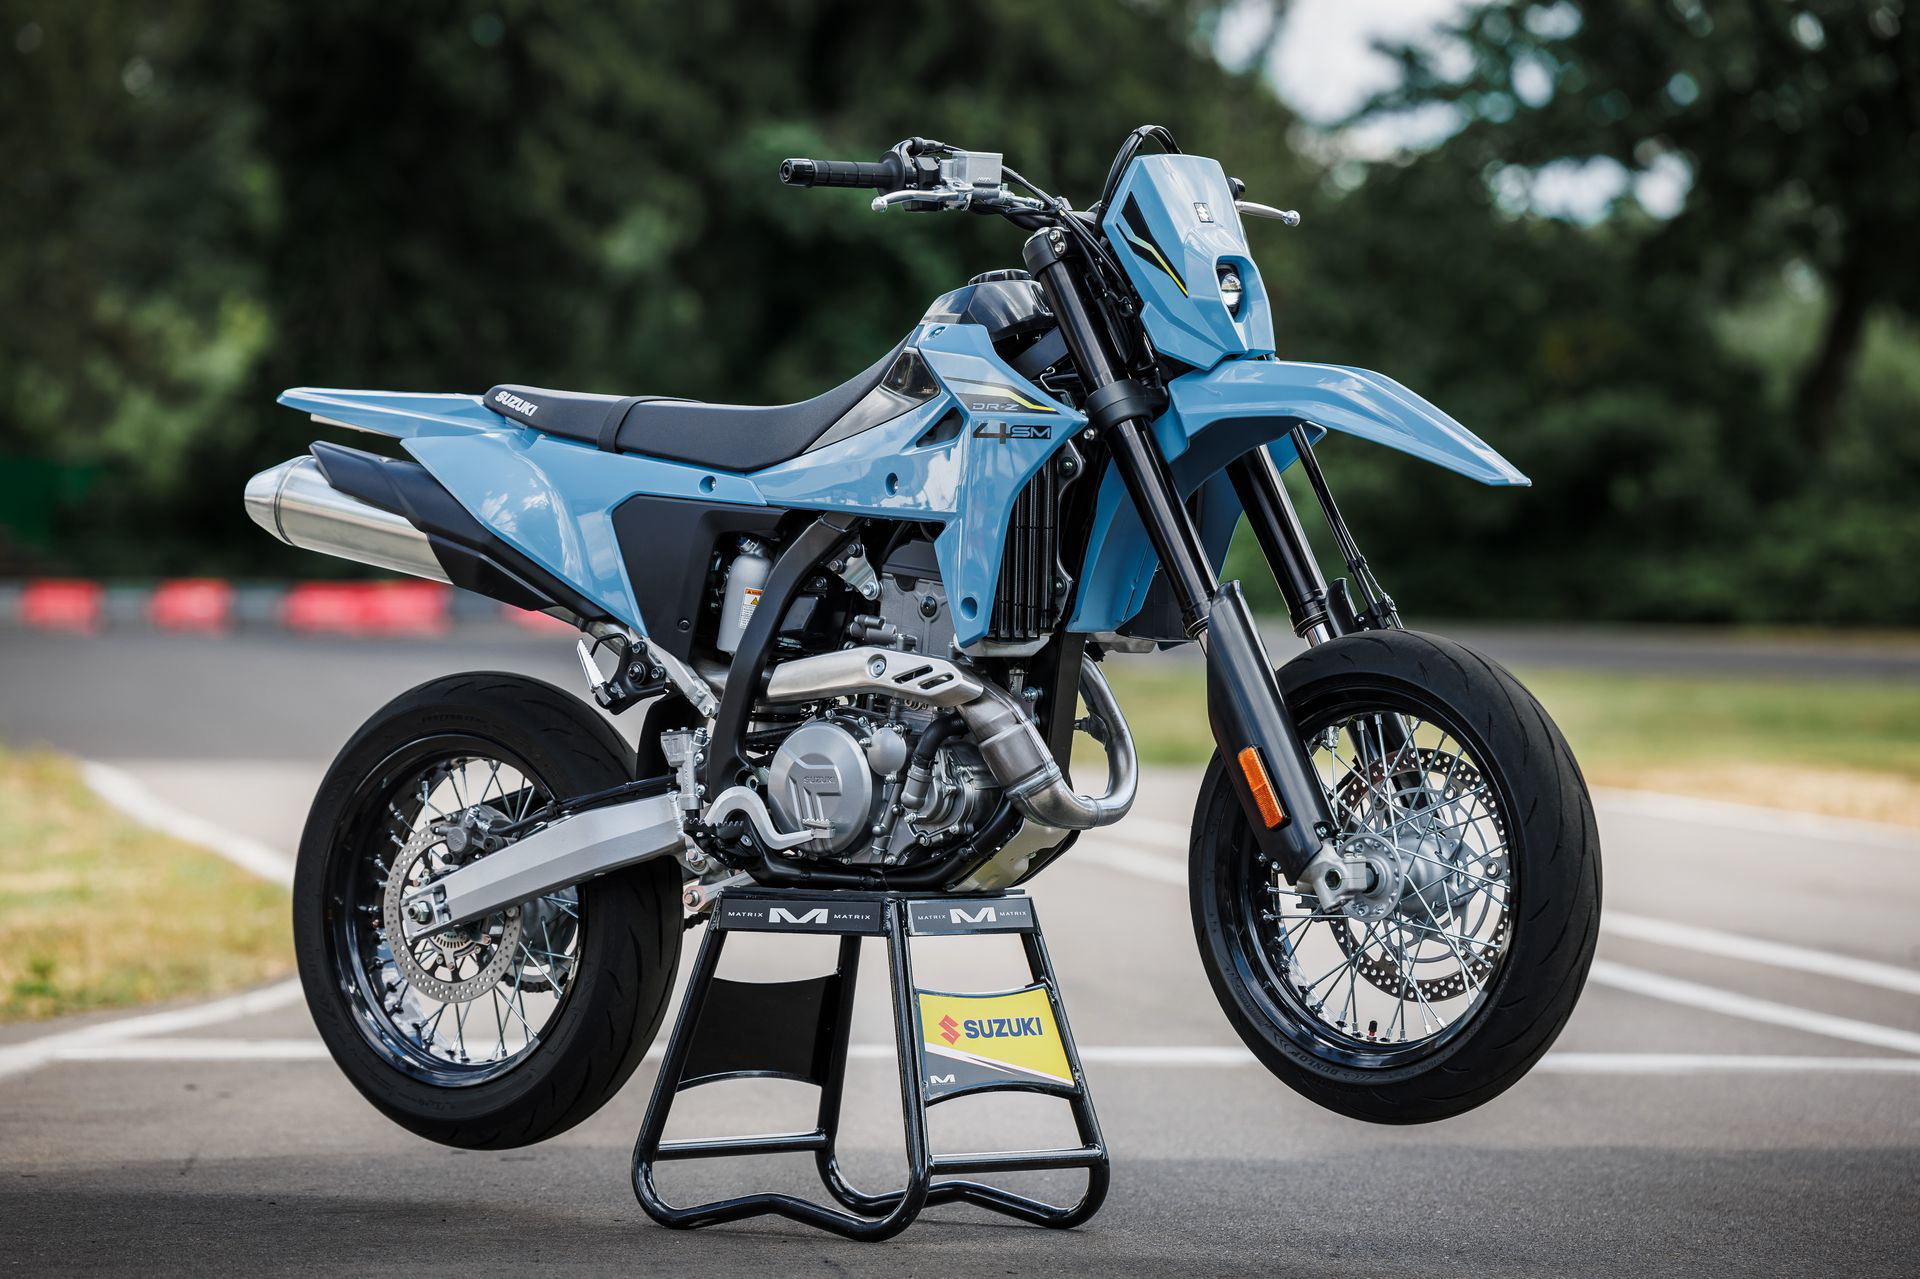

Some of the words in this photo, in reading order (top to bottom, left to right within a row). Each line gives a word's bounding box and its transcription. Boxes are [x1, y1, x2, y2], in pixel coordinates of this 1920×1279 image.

[494, 390, 538, 417] SUZUKI
[972, 402, 1020, 411] DR-Z
[963, 1016, 1044, 1039] SUZUKI
[1288, 1050, 1340, 1075] DUNLOP
